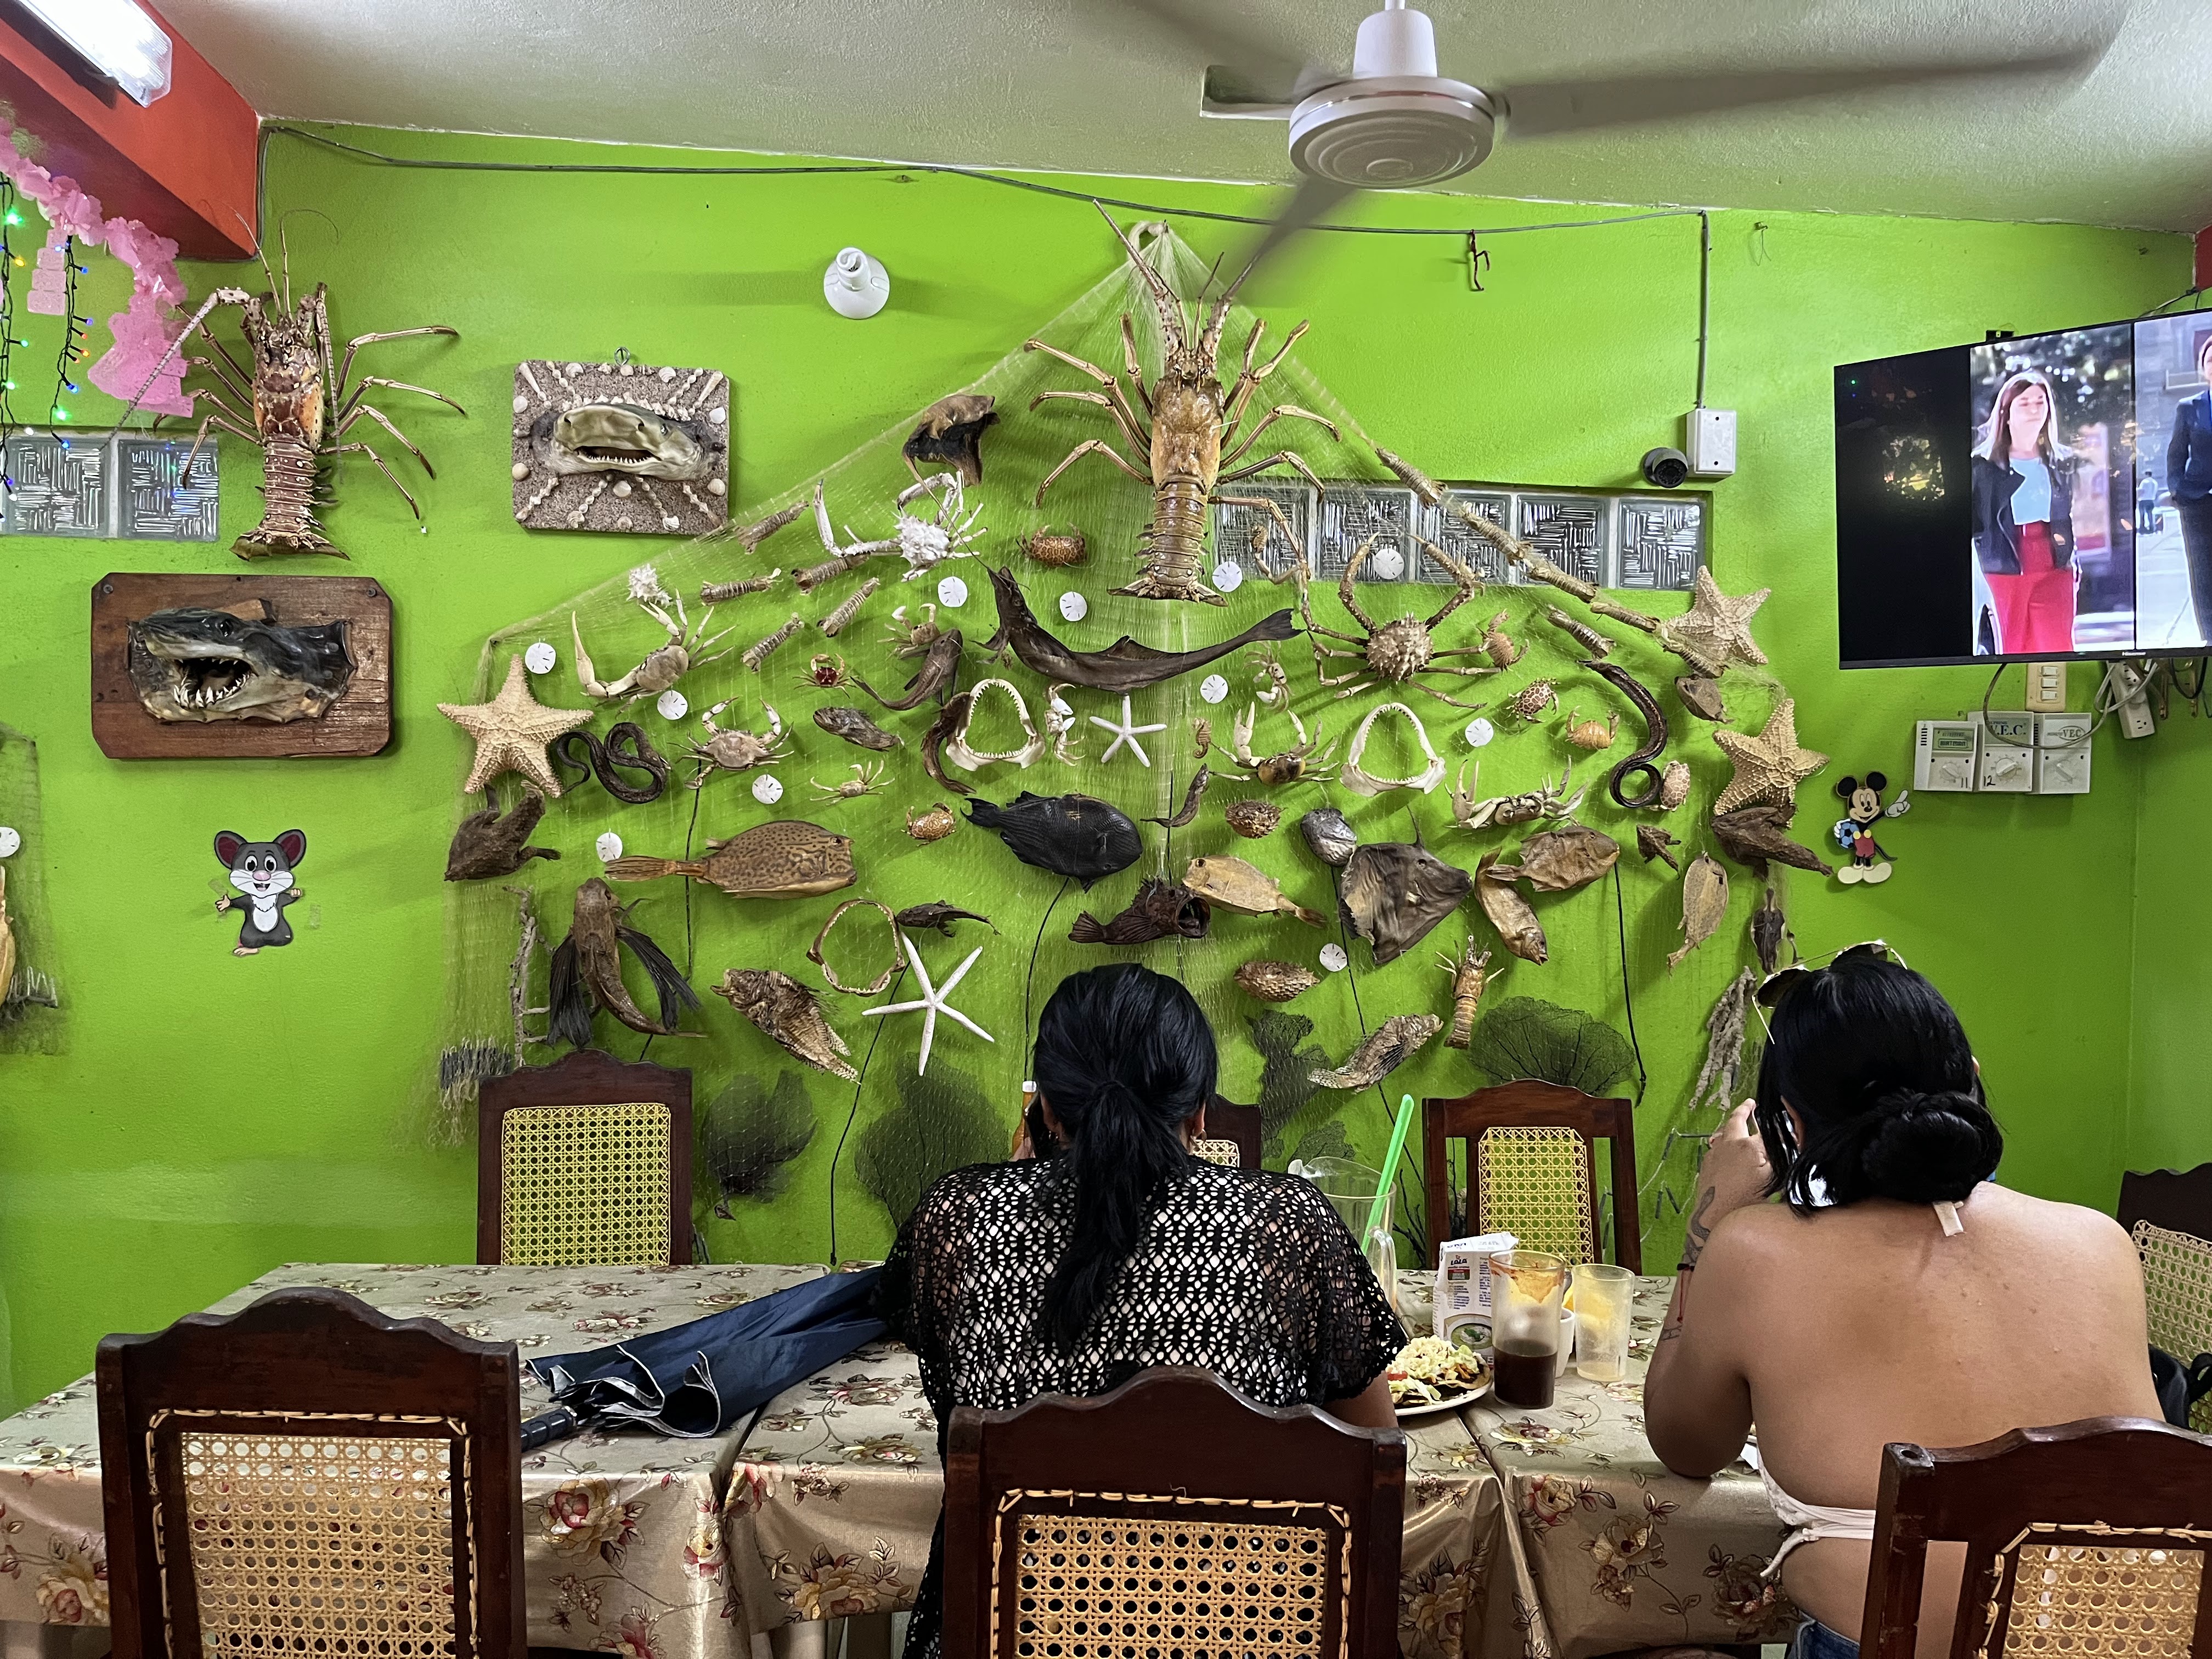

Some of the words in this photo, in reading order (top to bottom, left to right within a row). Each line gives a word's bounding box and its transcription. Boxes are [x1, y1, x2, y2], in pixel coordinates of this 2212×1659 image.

[2063, 729, 2081, 738] VEC
[1961, 777, 1968, 788] 11
[1983, 775, 1996, 787] 12
